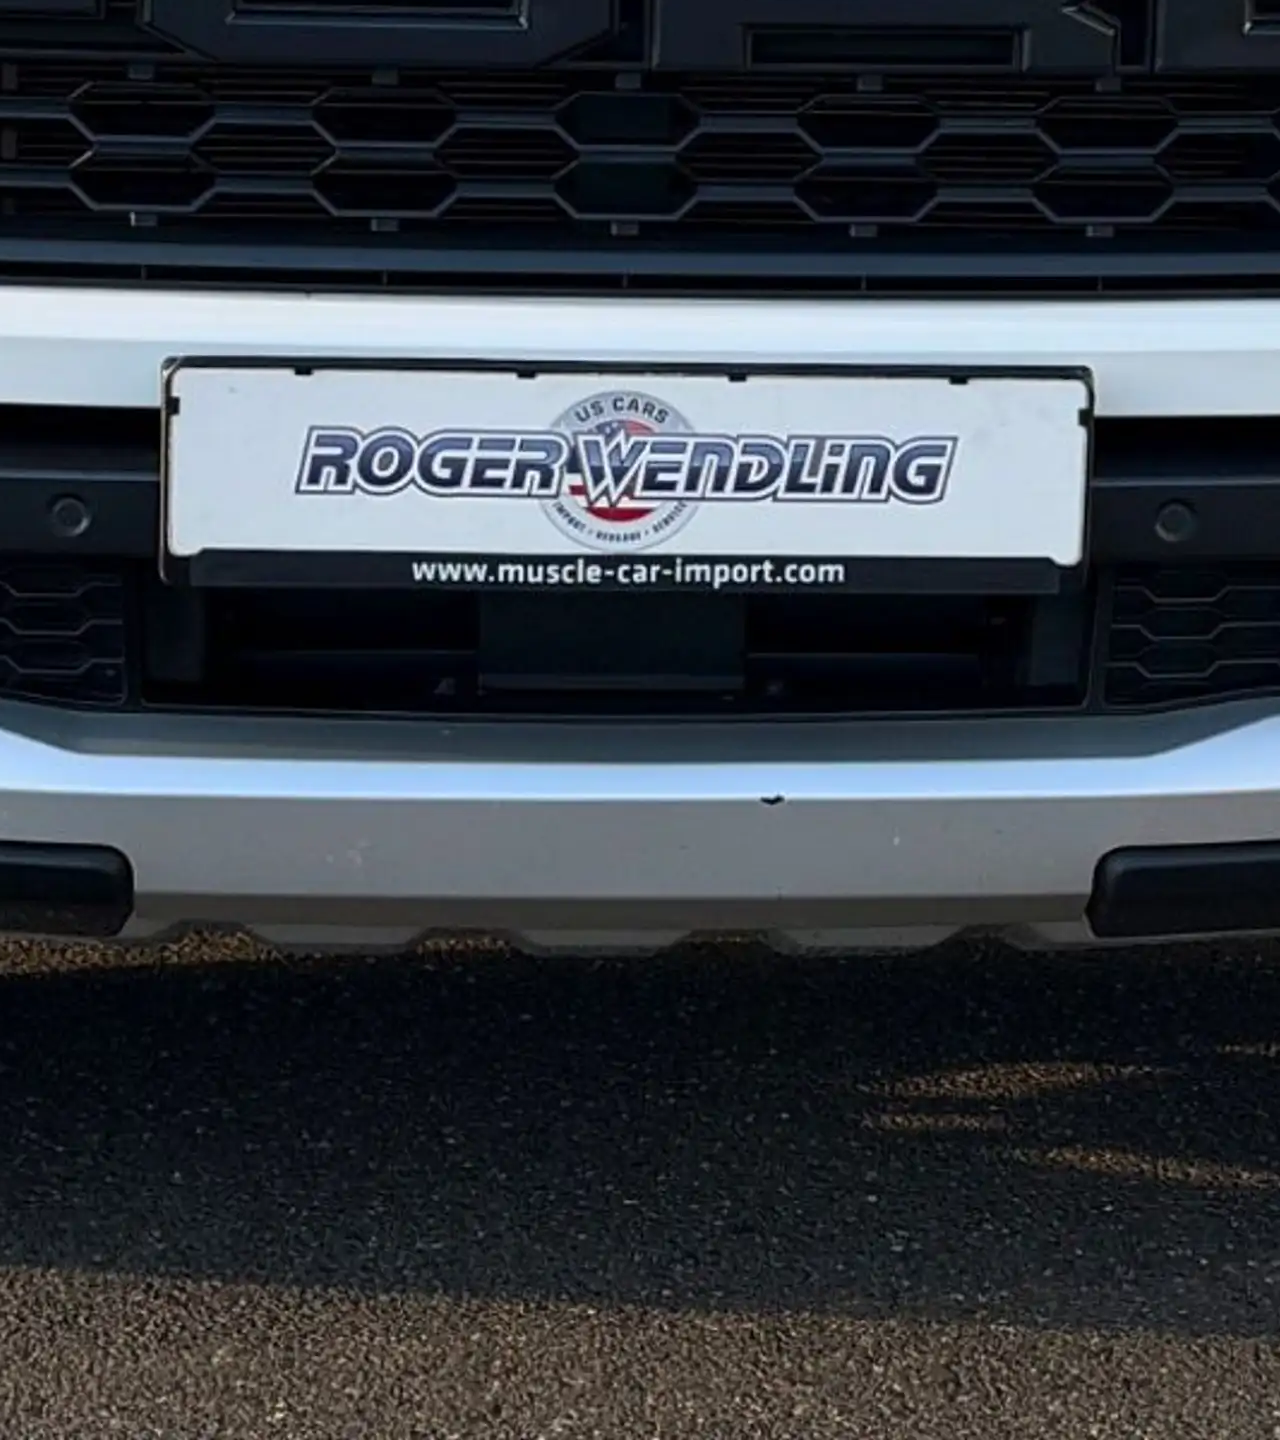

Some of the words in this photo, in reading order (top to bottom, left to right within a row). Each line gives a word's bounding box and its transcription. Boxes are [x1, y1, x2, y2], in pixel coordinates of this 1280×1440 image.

[574, 400, 605, 423] US
[613, 396, 669, 424] CARS
[295, 426, 569, 498] ROGER
[412, 558, 846, 589] www.muscle-car-import.com
